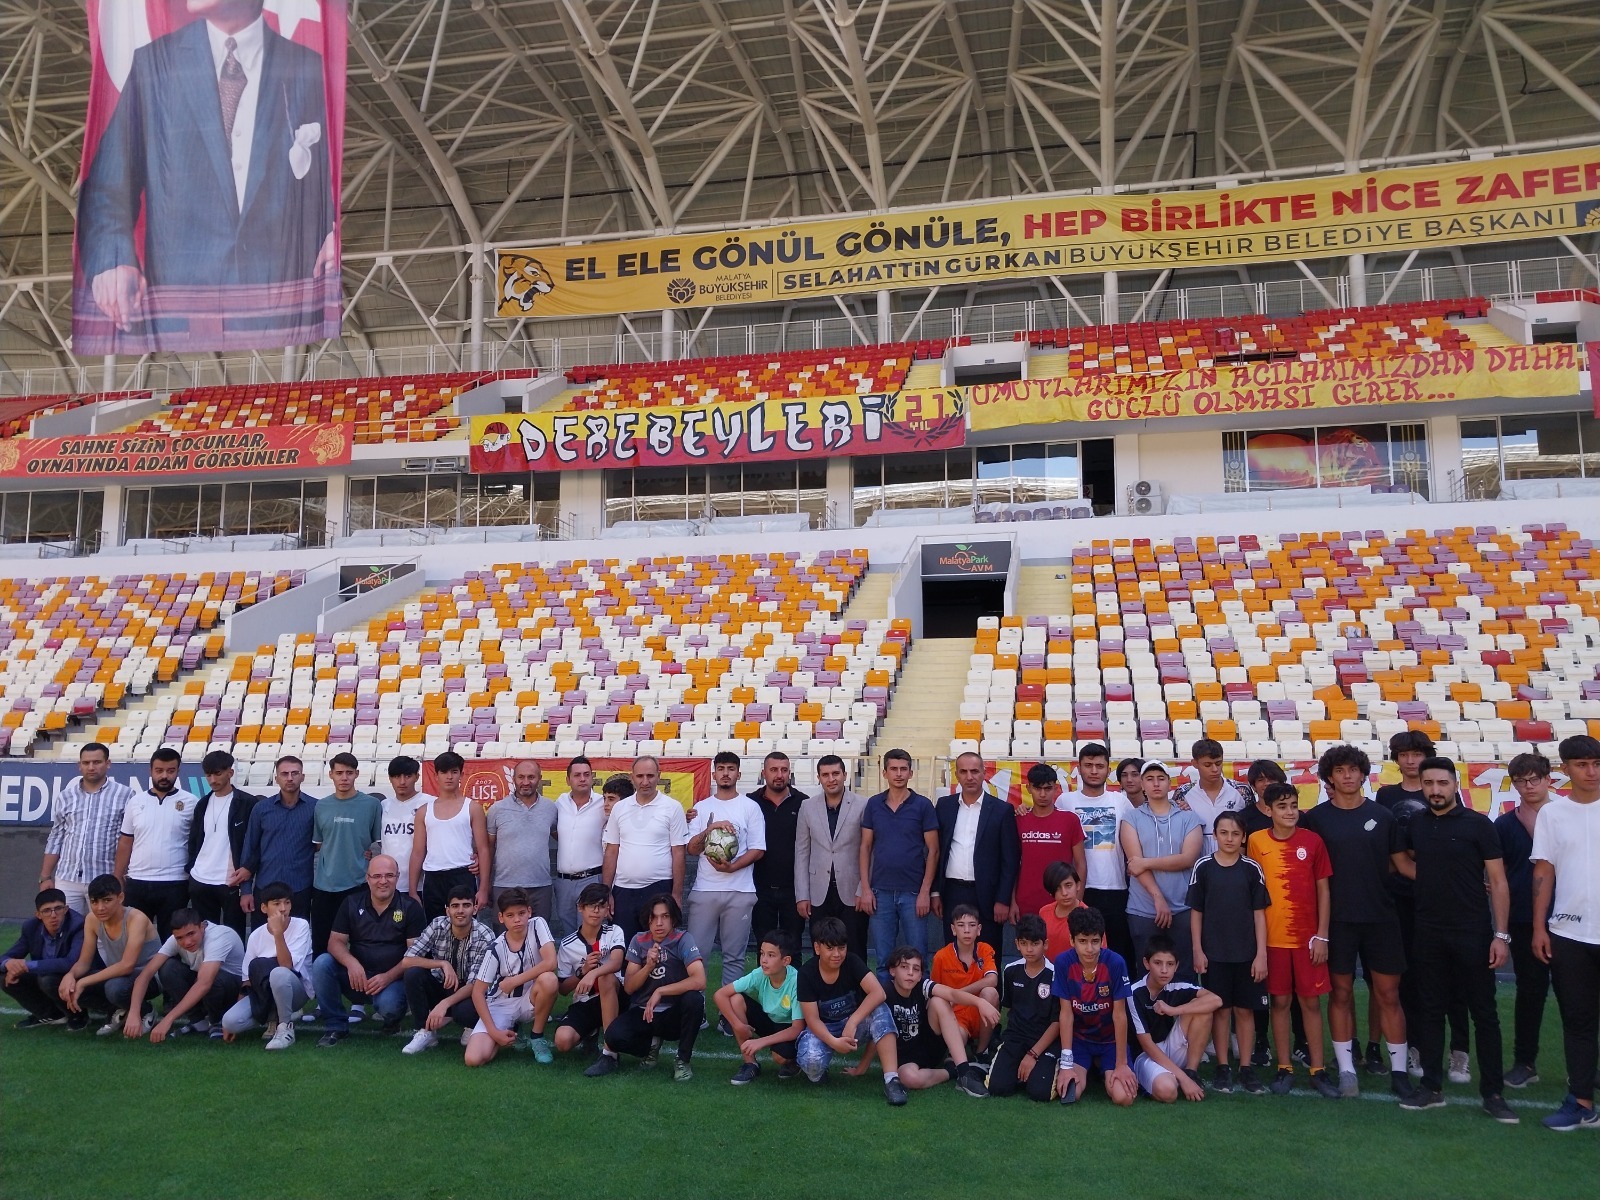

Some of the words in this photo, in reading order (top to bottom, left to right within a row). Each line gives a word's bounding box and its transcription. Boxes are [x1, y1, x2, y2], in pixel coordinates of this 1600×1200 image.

[565, 257, 606, 282] EL
[617, 248, 681, 277] ELE
[692, 231, 824, 271] GÖNÜL
[835, 217, 1011, 257] GÖNÜLE,
[1024, 208, 1106, 239] HEP
[1121, 193, 1316, 233] BİRLİKTE
[1331, 177, 1442, 216] NİCE
[1069, 237, 1253, 265] BÜYÜKŞEHİR
[1265, 222, 1413, 252] BELEDİYE
[1424, 207, 1564, 238] BAŞKANI
[716, 273, 752, 282] MALATYA
[972, 366, 1218, 405] UMUTLARIMIZIN
[1232, 350, 1475, 389] ACILARIMIZDAN
[1485, 344, 1576, 373] DAHA
[1194, 384, 1315, 415] OLMASI
[59, 440, 116, 456] SAHNE
[121, 437, 166, 454] SİZİN
[171, 432, 269, 456] ÇOCUKLAR,
[27, 456, 129, 473] OYNAYINDA
[133, 454, 189, 472] ADAM
[193, 448, 300, 469] GÖRSÜNLER
[939, 555, 988, 566] MalatyaPark
[970, 564, 993, 572] AVM
[384, 822, 415, 836] AVIS
[1021, 831, 1051, 839] adidas
[1072, 999, 1110, 1013] Rakuten
